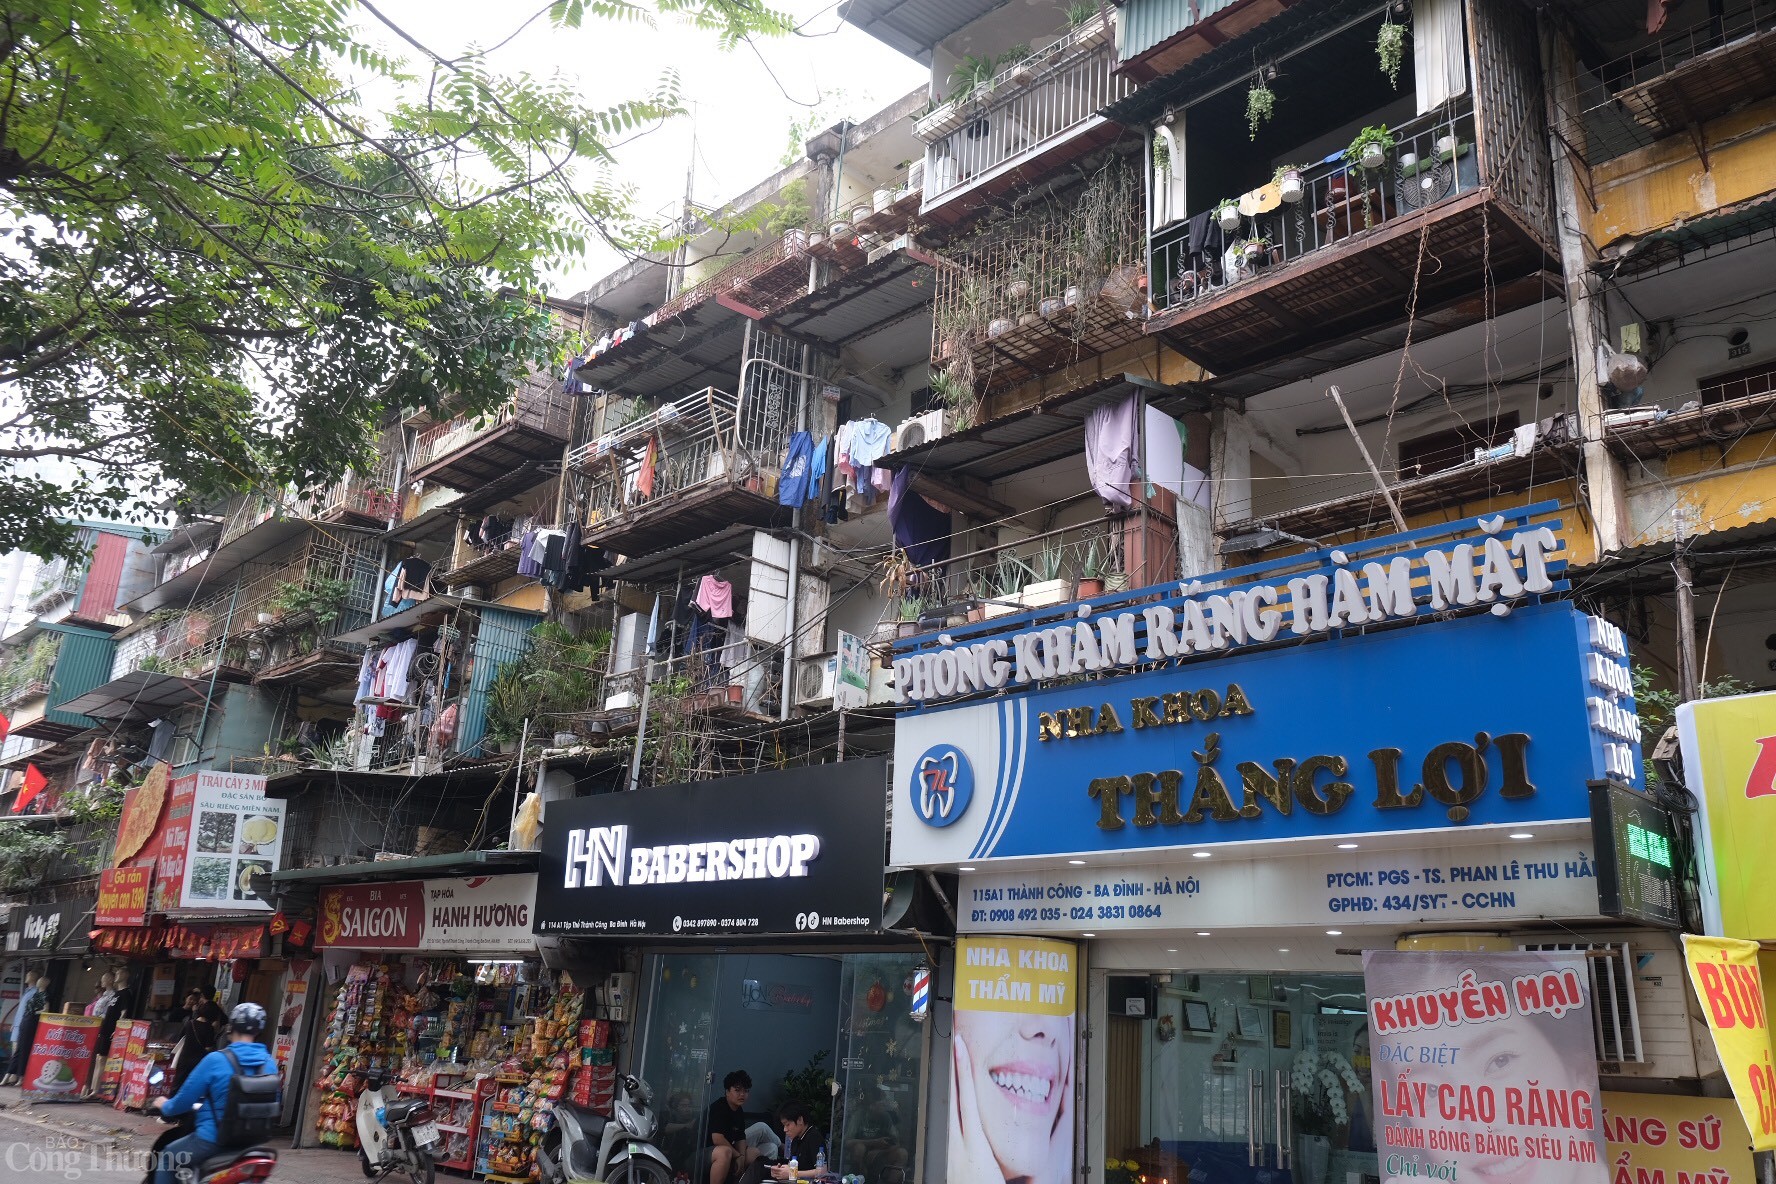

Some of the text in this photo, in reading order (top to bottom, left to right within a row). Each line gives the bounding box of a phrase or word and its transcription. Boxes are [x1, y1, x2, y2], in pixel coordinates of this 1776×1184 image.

[892, 515, 1557, 704] PHÒNG KHÁM RĂNG HÀM MẶT
[1587, 615, 1626, 657] NHA
[1586, 652, 1634, 697] KHOA
[1038, 683, 1254, 742] NHA KHOA
[202, 774, 224, 788] TRÁI
[245, 779, 250, 790] 3
[1088, 731, 1537, 830] THẮNG LỢI
[564, 824, 628, 889] HN
[628, 834, 820, 885] BABERSHOP
[973, 889, 1003, 902] 115A1
[1007, 883, 1044, 901] THÀNH
[1046, 883, 1083, 900] CÔNG
[1094, 884, 1110, 898] BA
[1113, 879, 1144, 897] ĐÌNH
[1154, 877, 1172, 895] HÀ
[1176, 876, 1200, 898] NỘI
[1327, 871, 1374, 888] PTCM:
[1378, 869, 1410, 885] PGS
[1423, 868, 1446, 884] TS.
[1450, 865, 1498, 883] PHAN
[1502, 860, 1520, 880] LÊ
[1524, 862, 1559, 880] THU
[370, 890, 382, 901] BIA
[430, 887, 454, 902] TẠP HÓA
[1328, 897, 1378, 913] GPHĐ:
[1462, 892, 1516, 909] CCHN
[341, 906, 408, 937] SAIGON
[432, 903, 528, 934] HẠNH HƯƠNG
[822, 916, 870, 926] HN Babershop
[972, 909, 987, 922] ĐT:
[990, 908, 1015, 922] 0908
[1018, 907, 1038, 921] 492
[1040, 907, 1061, 921] 035
[1070, 906, 1093, 920] 024
[1098, 905, 1125, 919] 3831
[1128, 904, 1162, 918] 0864
[966, 947, 1069, 973] NHA KHOA
[968, 973, 1066, 1005] THẨM MỸ
[1373, 971, 1581, 1032] KHUYẾN MẠI
[1696, 949, 1766, 1029] BÚN
[1379, 1042, 1460, 1067] ĐẶC BIỆT
[1380, 1068, 1595, 1131] LẤY CAO RĂNG
[1385, 1122, 1597, 1164] ĐÁNH BÓNG BẰNG SIÊU ÂM
[1678, 1114, 1721, 1150] SỨ
[1386, 1153, 1458, 1182] Chỉ với
